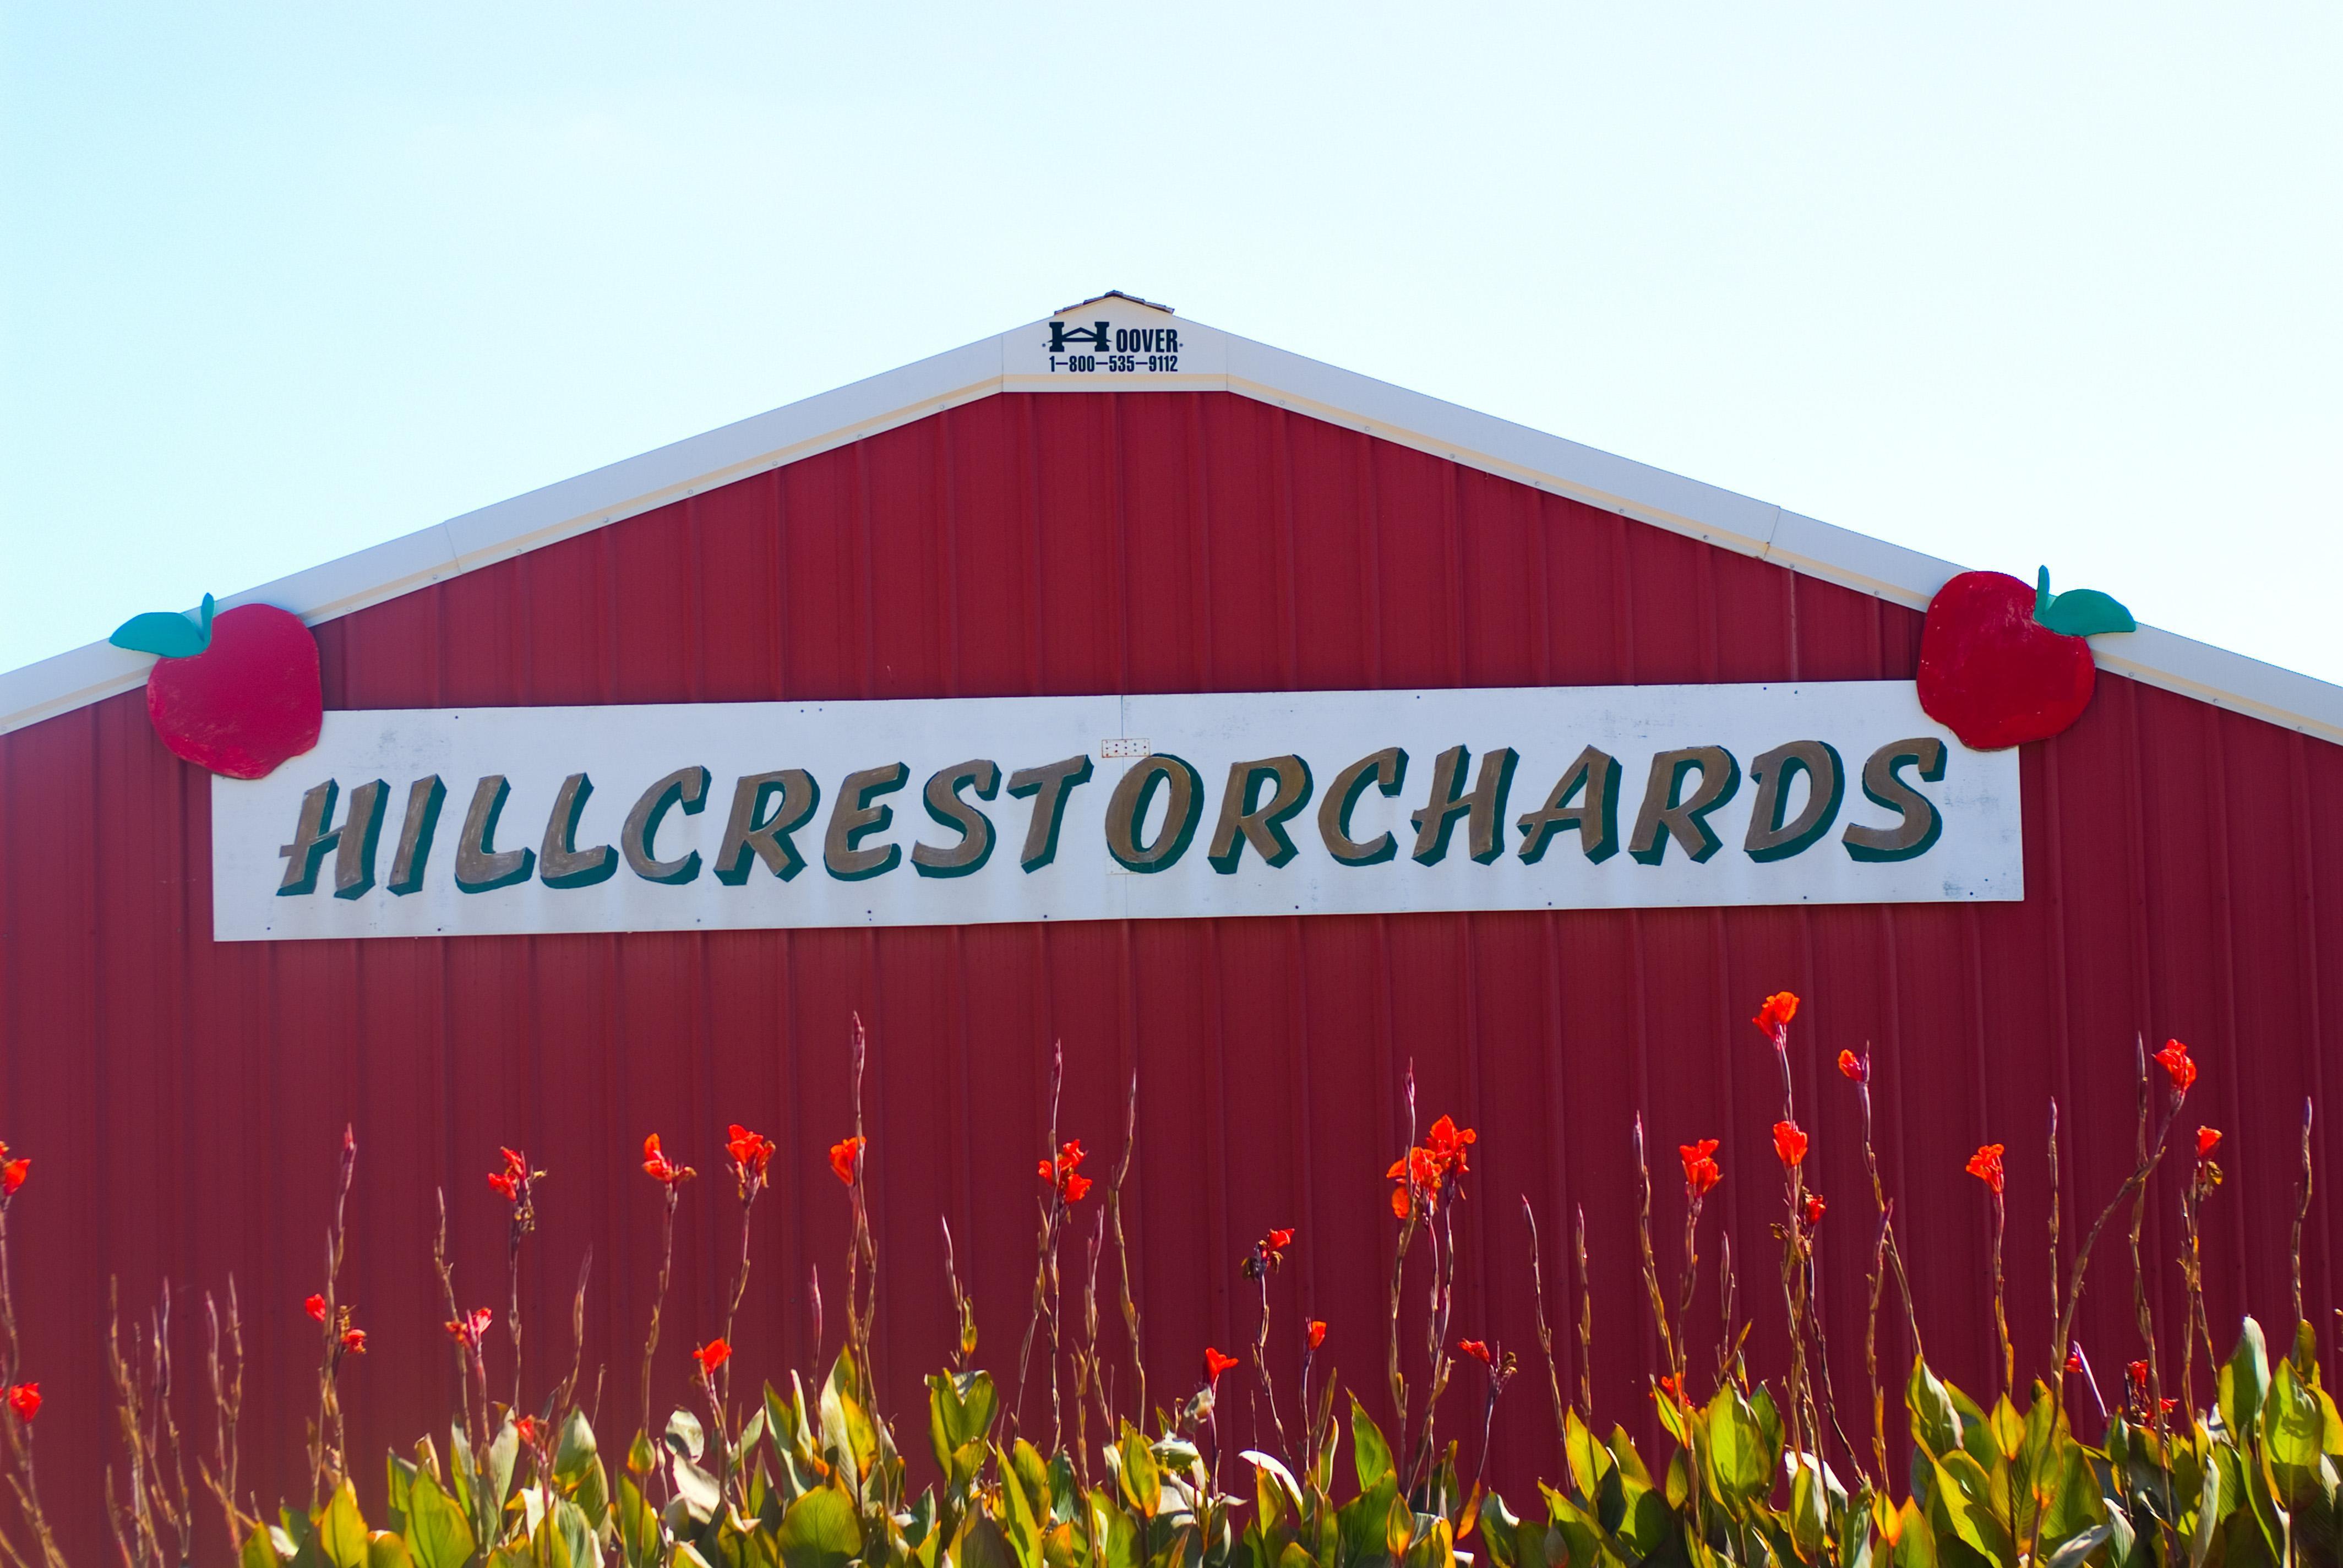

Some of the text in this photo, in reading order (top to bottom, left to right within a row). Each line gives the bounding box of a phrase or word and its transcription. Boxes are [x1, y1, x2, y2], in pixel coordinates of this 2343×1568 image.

[1049, 355, 1178, 372] 1-800-535-9112
[276, 737, 1948, 900] HILLCREST ORCHARDS
